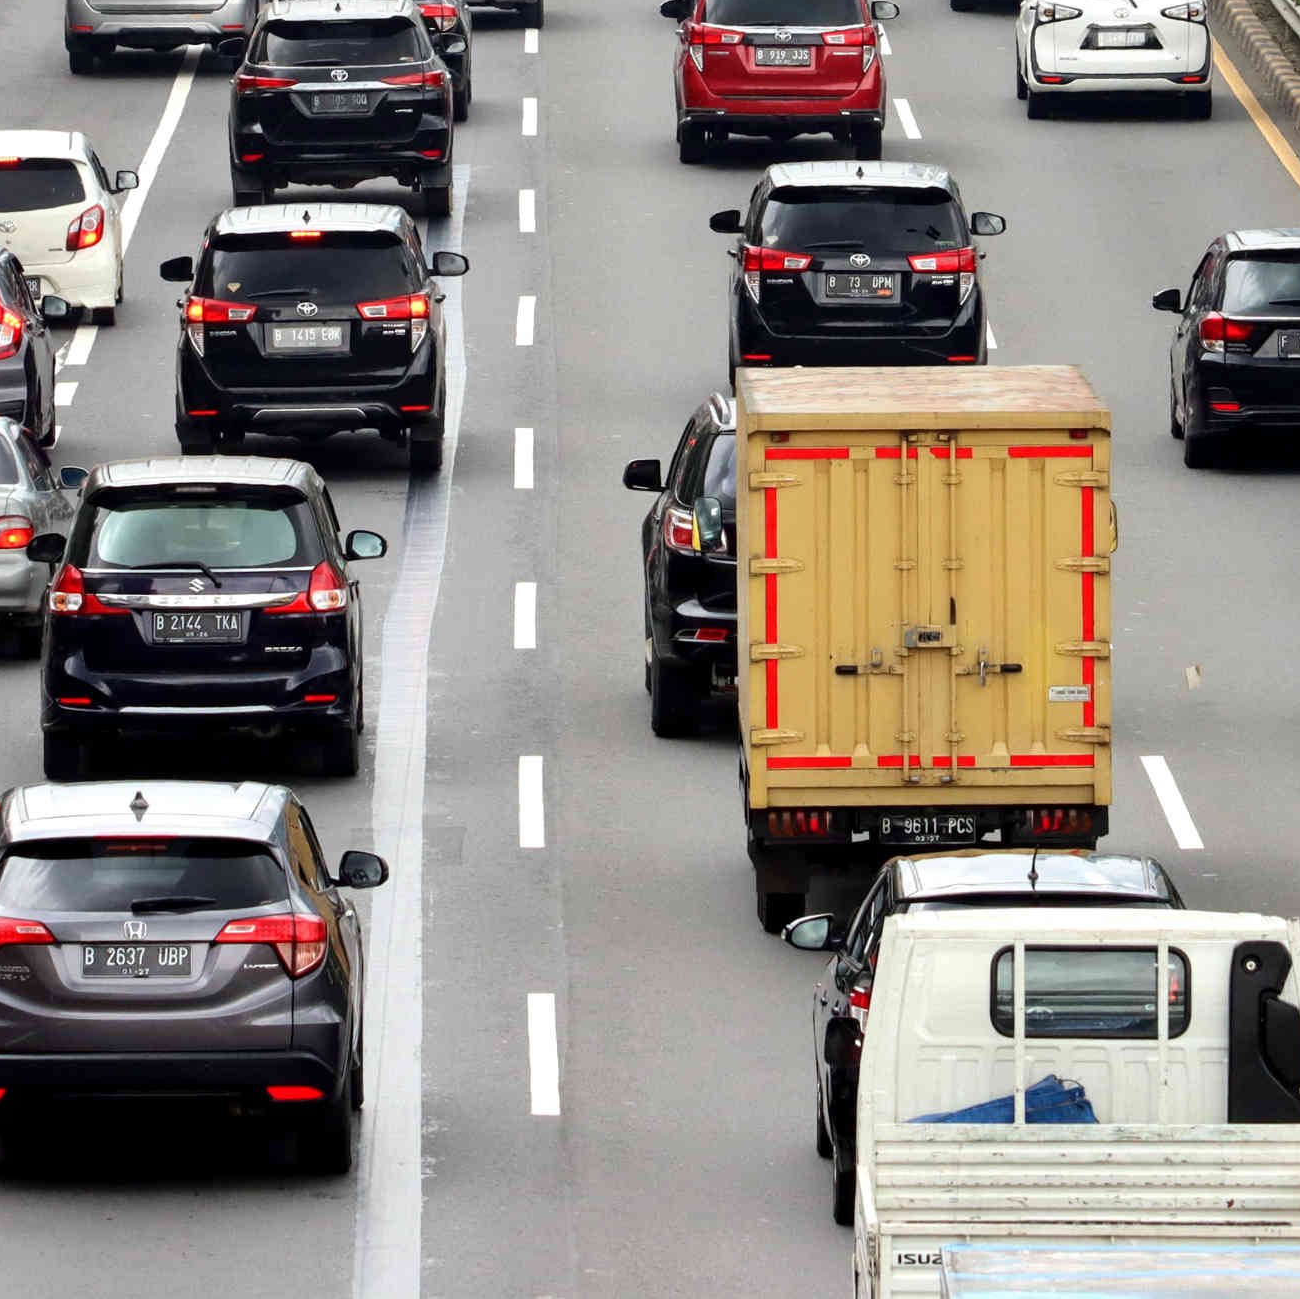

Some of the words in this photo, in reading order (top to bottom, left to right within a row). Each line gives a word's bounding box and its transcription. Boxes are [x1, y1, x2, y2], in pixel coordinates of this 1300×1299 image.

[757, 49, 763, 60] B
[829, 276, 836, 288] B
[848, 276, 860, 288] 73
[274, 329, 281, 341] B
[292, 329, 316, 341] 1415
[1281, 337, 1288, 348] F
[156, 614, 163, 630] B
[215, 614, 238, 630] TKA
[882, 819, 891, 834] B
[904, 819, 937, 834] 9611
[948, 818, 974, 834] PCS
[85, 948, 94, 965] B
[106, 948, 145, 965] 2637
[158, 948, 189, 966] UBP
